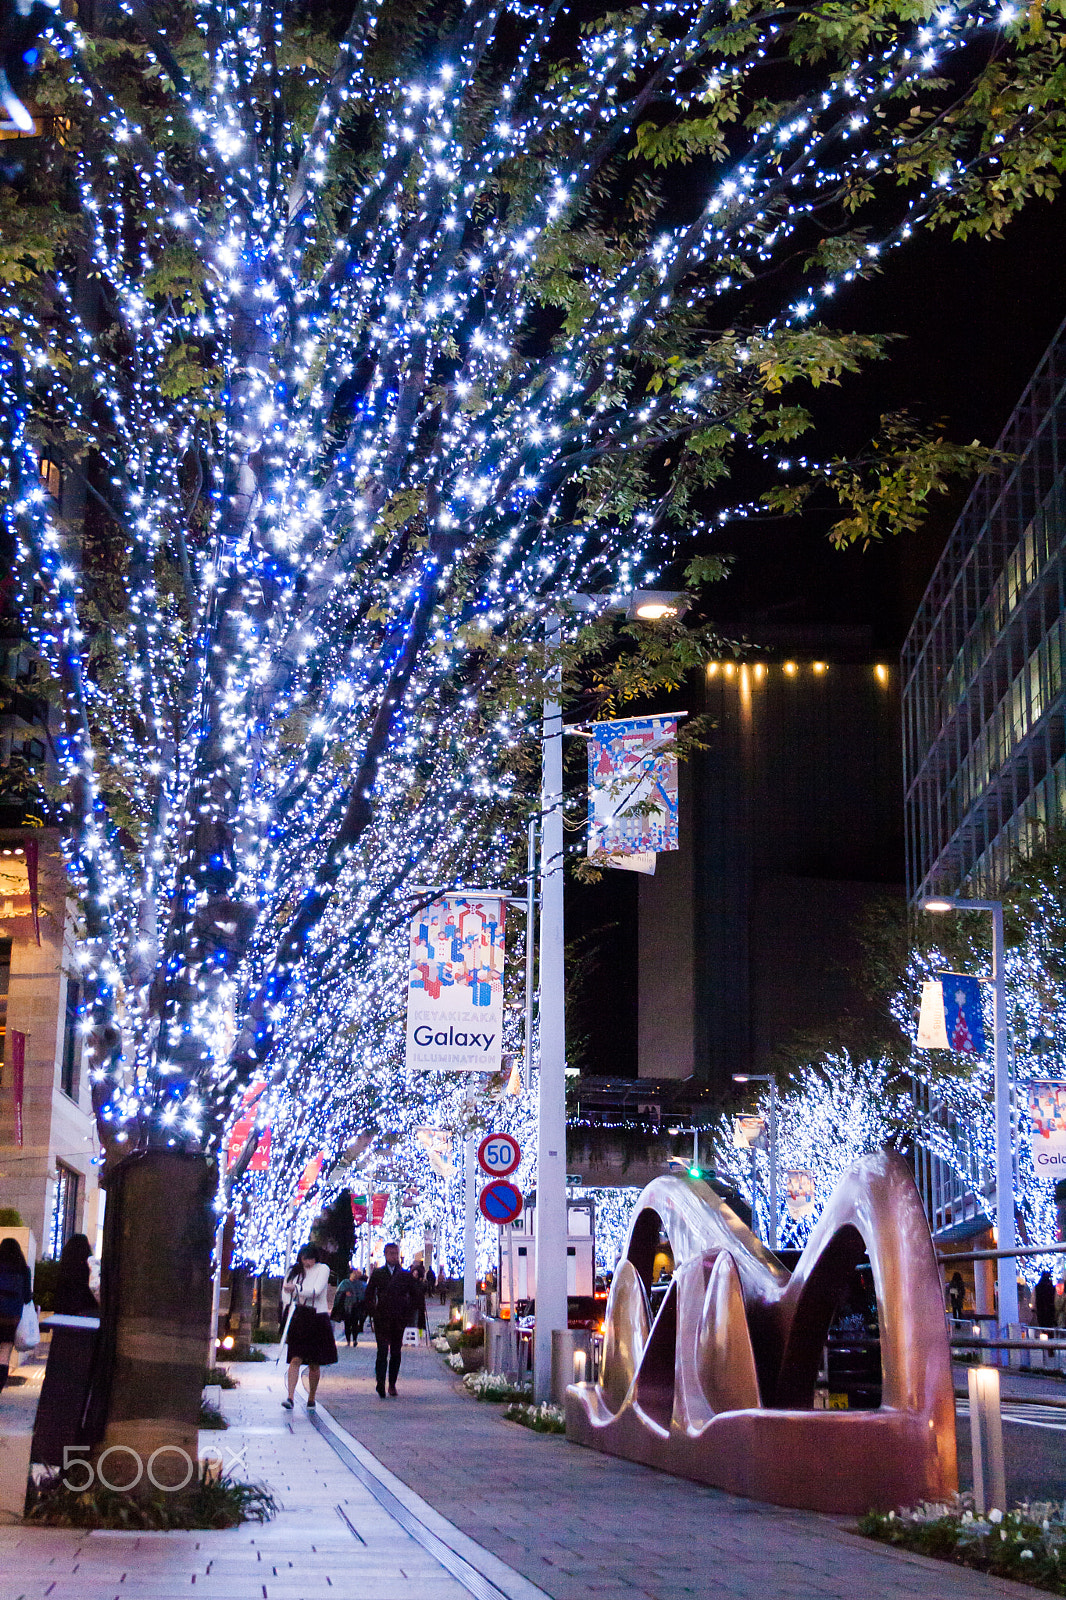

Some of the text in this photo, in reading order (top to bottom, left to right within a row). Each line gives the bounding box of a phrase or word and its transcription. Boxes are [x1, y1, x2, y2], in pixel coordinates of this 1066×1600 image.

[414, 1010, 497, 1022] KEYAKIZAKA
[413, 1025, 496, 1051] Galaxy
[413, 1053, 496, 1063] ILLUMINATION
[231, 1143, 268, 1156] Gaxy
[487, 1145, 512, 1165] 50
